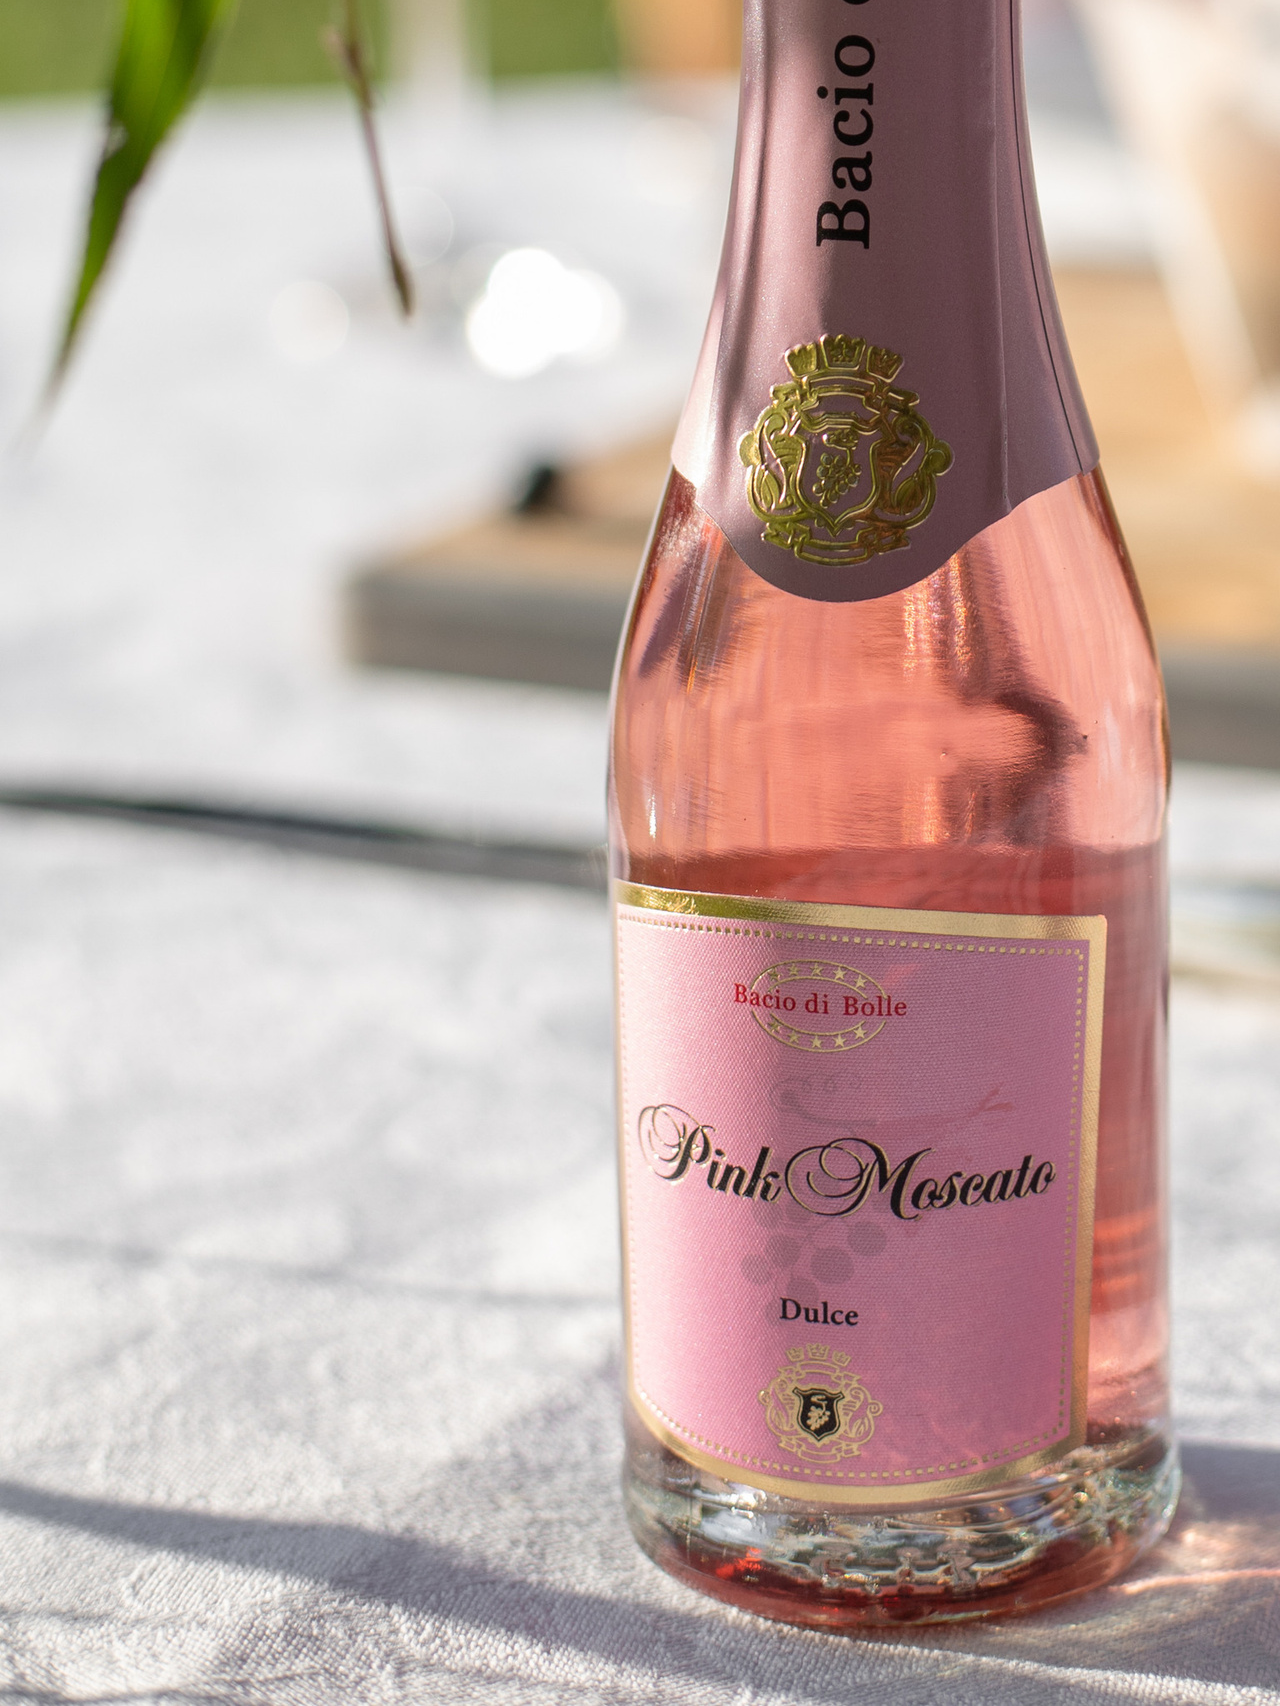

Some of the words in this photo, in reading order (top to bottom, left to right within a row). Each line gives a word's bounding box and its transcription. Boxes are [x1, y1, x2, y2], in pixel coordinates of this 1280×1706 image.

[815, 34, 875, 249] Bacio
[733, 982, 797, 1012] Bacio
[804, 992, 830, 1015] di
[842, 994, 908, 1017] Bolle
[638, 1103, 785, 1204] Pink
[785, 1137, 1057, 1222] Moscato
[778, 1296, 860, 1327] Dulce
